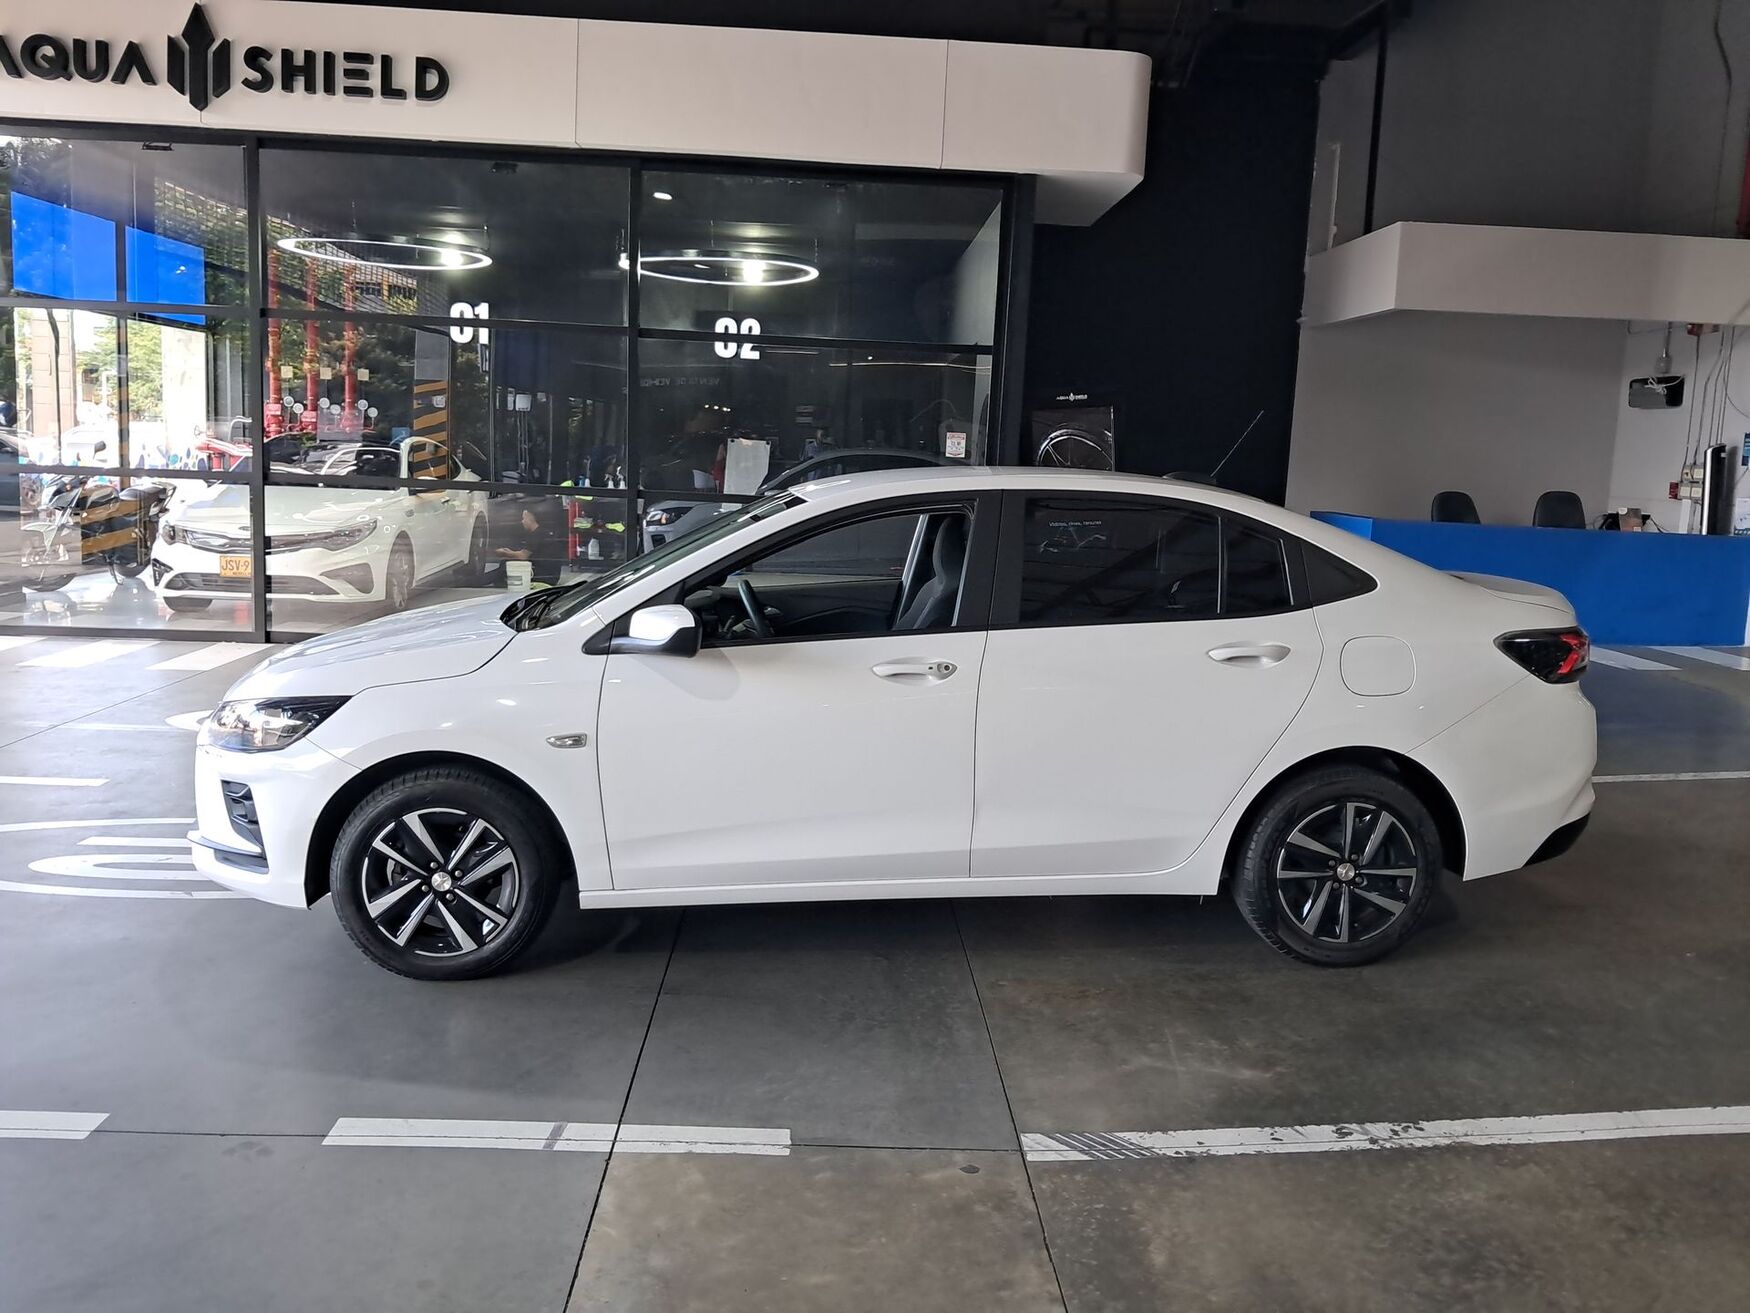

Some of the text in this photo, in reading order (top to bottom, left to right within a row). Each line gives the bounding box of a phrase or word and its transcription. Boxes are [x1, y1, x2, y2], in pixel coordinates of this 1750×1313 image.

[241, 46, 450, 101] SHIELD
[450, 302, 489, 344] 01
[714, 317, 761, 360] 02
